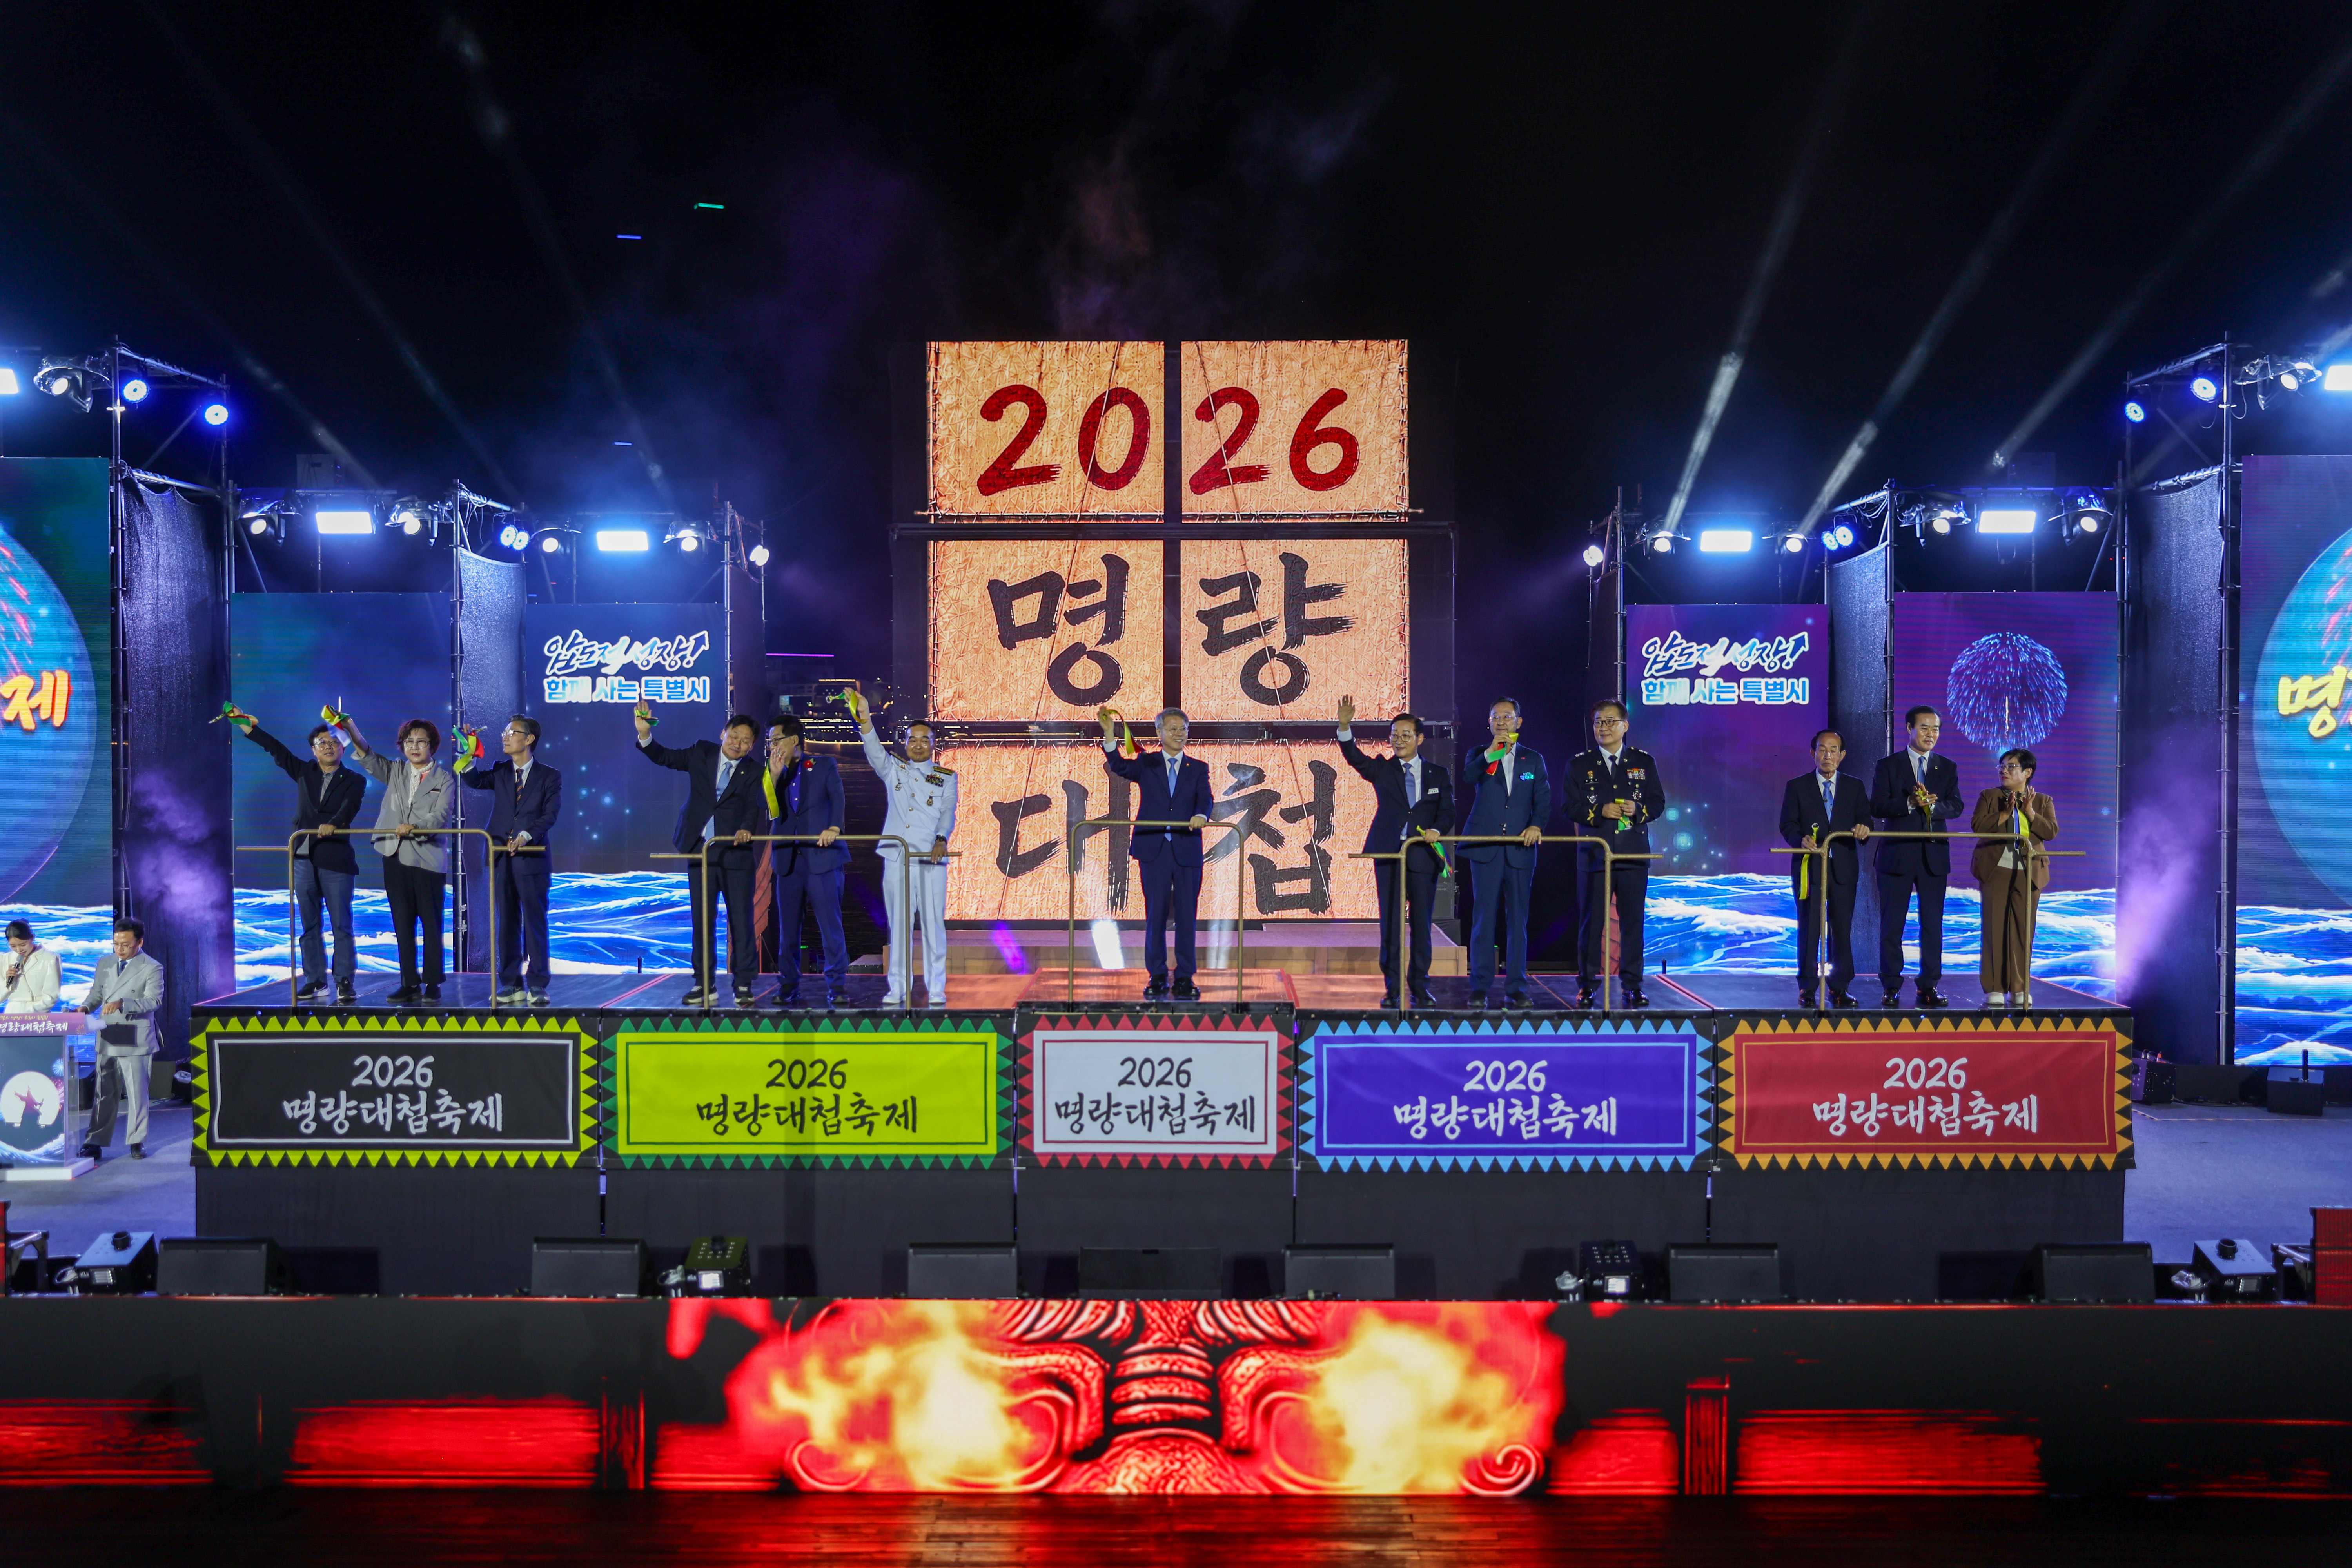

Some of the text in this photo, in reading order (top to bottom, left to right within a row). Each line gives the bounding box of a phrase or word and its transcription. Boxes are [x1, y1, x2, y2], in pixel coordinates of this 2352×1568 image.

[977, 384, 1360, 495] 2026
[987, 552, 1356, 707] 명량
[544, 676, 710, 703] 함께 사는 특별시
[1641, 678, 1809, 705] 함께 사는 특별시
[2278, 665, 2352, 738] 명
[991, 760, 1337, 915] 대첩
[352, 1055, 436, 1086] 2026
[766, 1059, 849, 1089] 2026
[1118, 1057, 1193, 1087] 2026
[1463, 1060, 1548, 1092] 2026
[1883, 1058, 1967, 1089] 2026
[283, 1089, 503, 1135] 명량대첩축제
[697, 1092, 917, 1137] 명량대첩축제
[1055, 1091, 1255, 1135] 명량대첩축제
[1394, 1094, 1616, 1139] 명량대첩축제
[1813, 1091, 2038, 1137] 명량대첩축제
